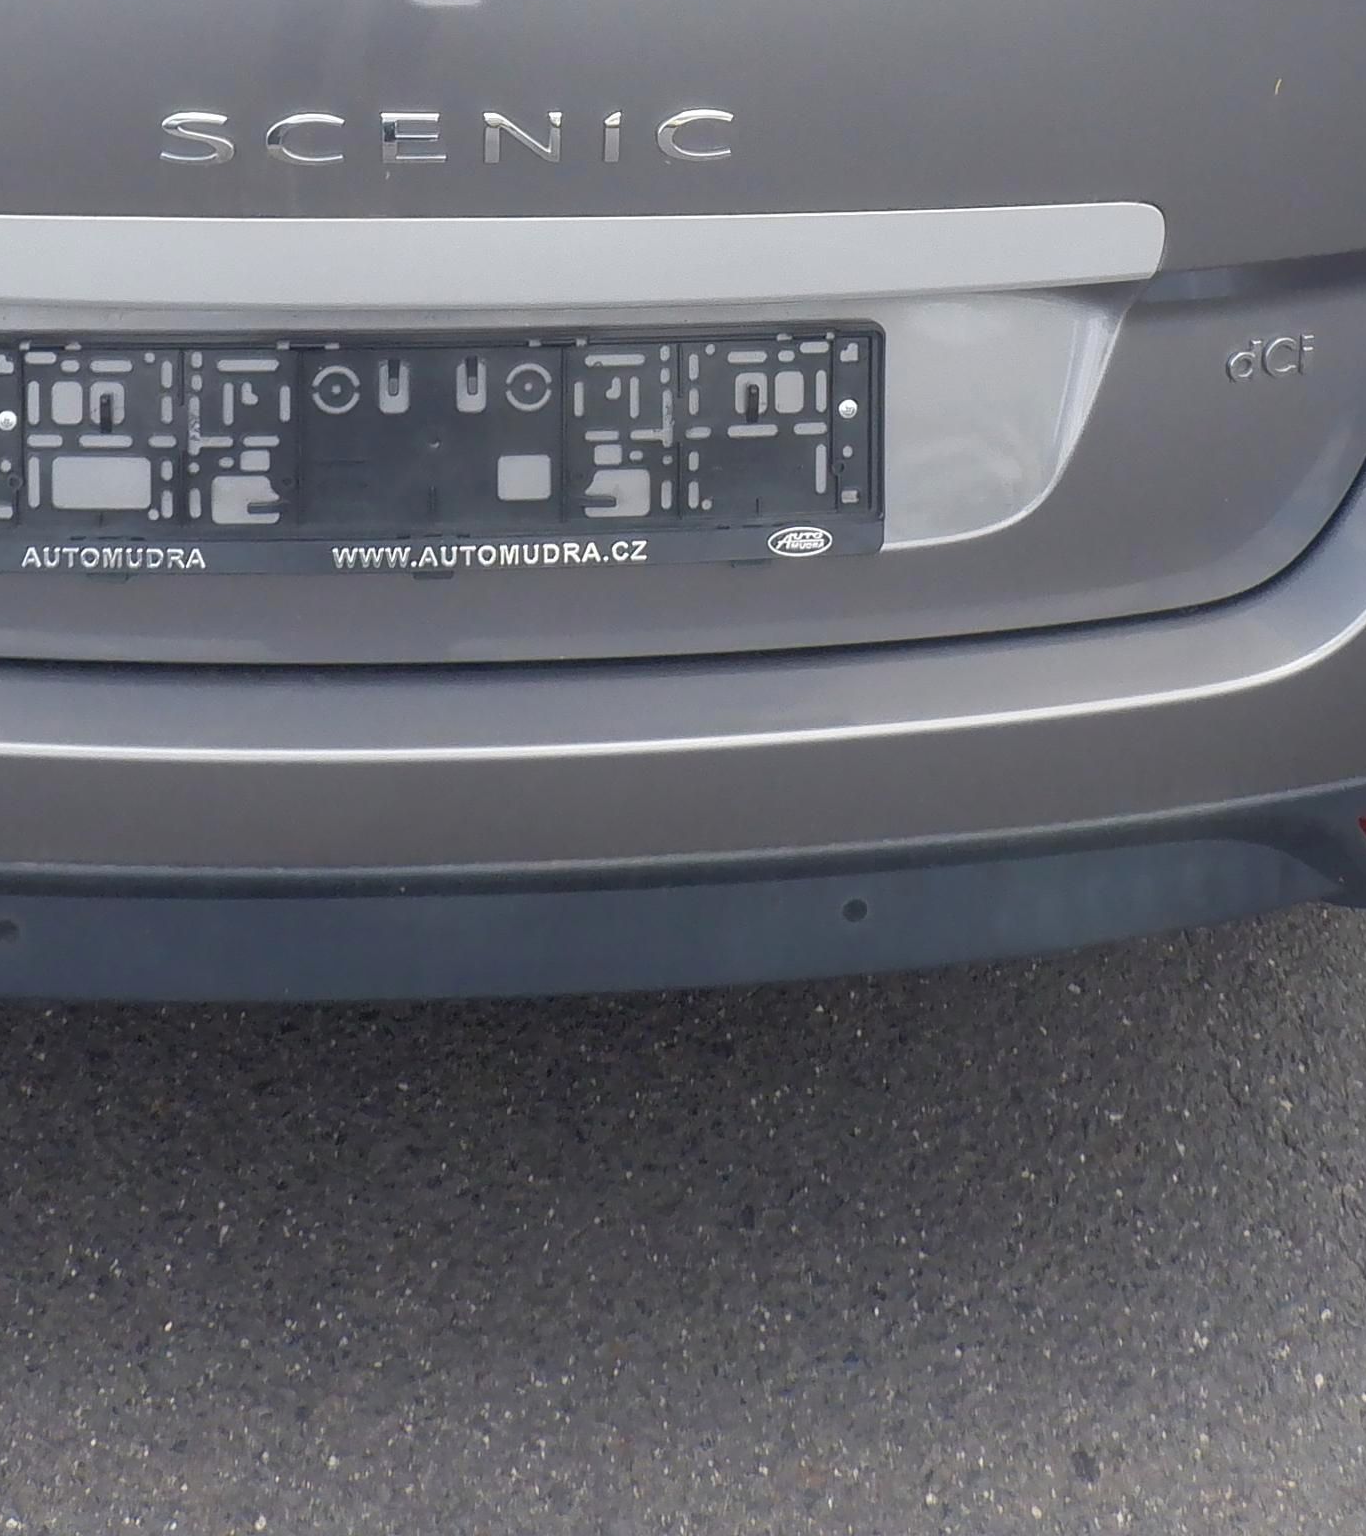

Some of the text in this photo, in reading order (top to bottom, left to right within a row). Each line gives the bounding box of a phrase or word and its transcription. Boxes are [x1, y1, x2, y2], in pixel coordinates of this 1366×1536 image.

[159, 109, 735, 164] SCENIC
[21, 546, 207, 569] AUTOMUDRA
[332, 540, 648, 569] WWW.AUTOMUDRA.CZ
